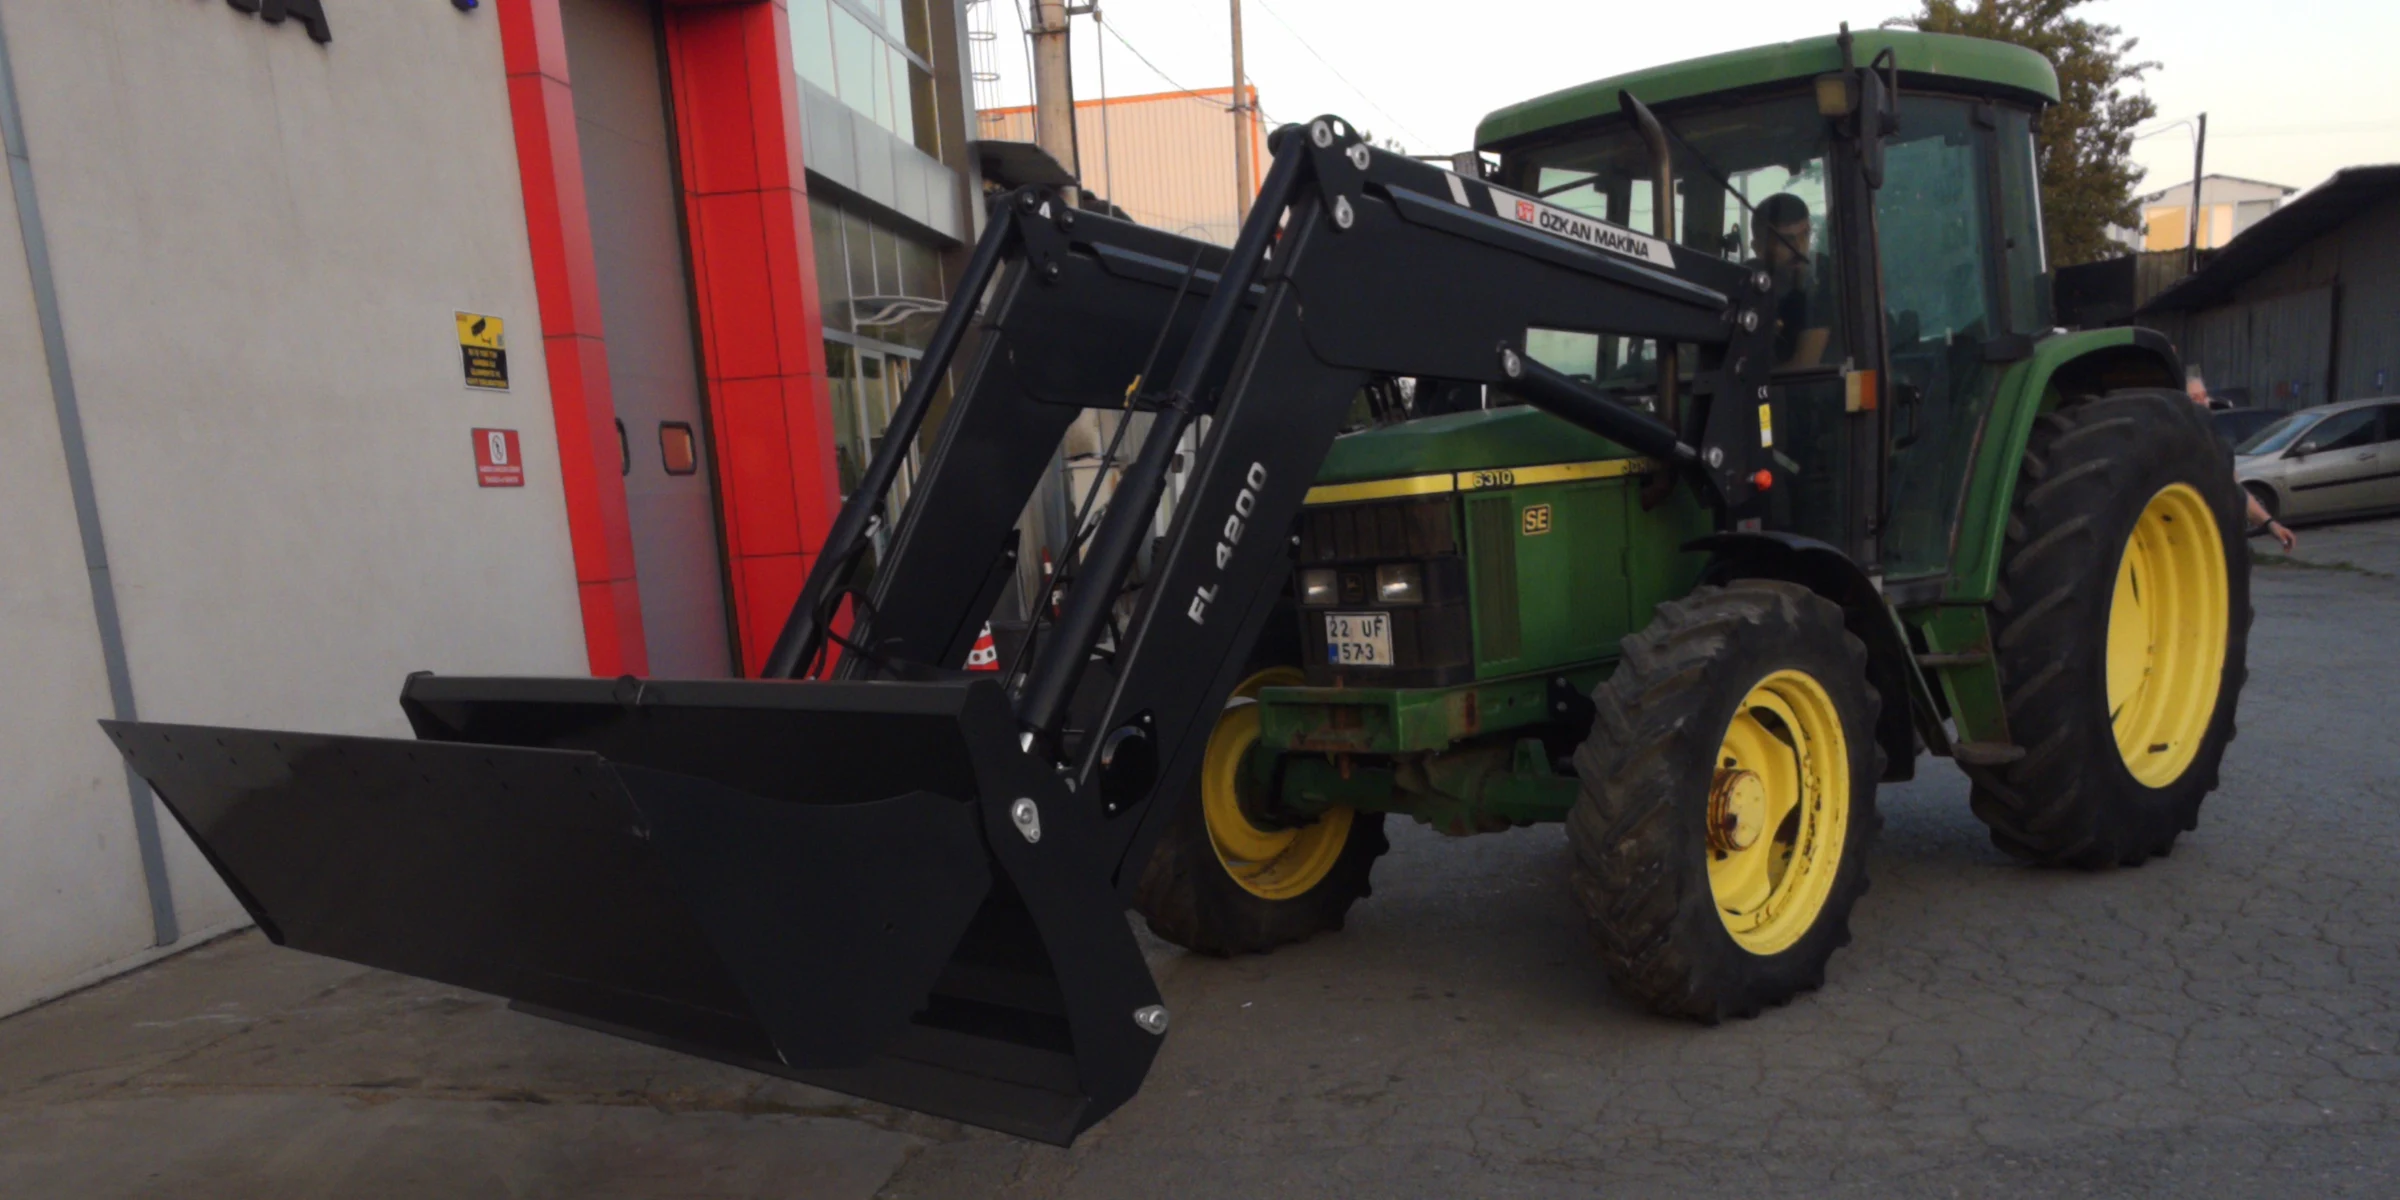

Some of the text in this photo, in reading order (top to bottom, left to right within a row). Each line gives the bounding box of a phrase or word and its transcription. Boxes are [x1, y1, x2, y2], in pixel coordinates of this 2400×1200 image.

[1539, 208, 1591, 242] ÖZKAN
[1473, 470, 1513, 488] 6310
[1525, 508, 1547, 530] SE
[1187, 461, 1268, 626] FL 4200
[1330, 618, 1383, 638] 22 UF
[1342, 643, 1374, 661] 573
